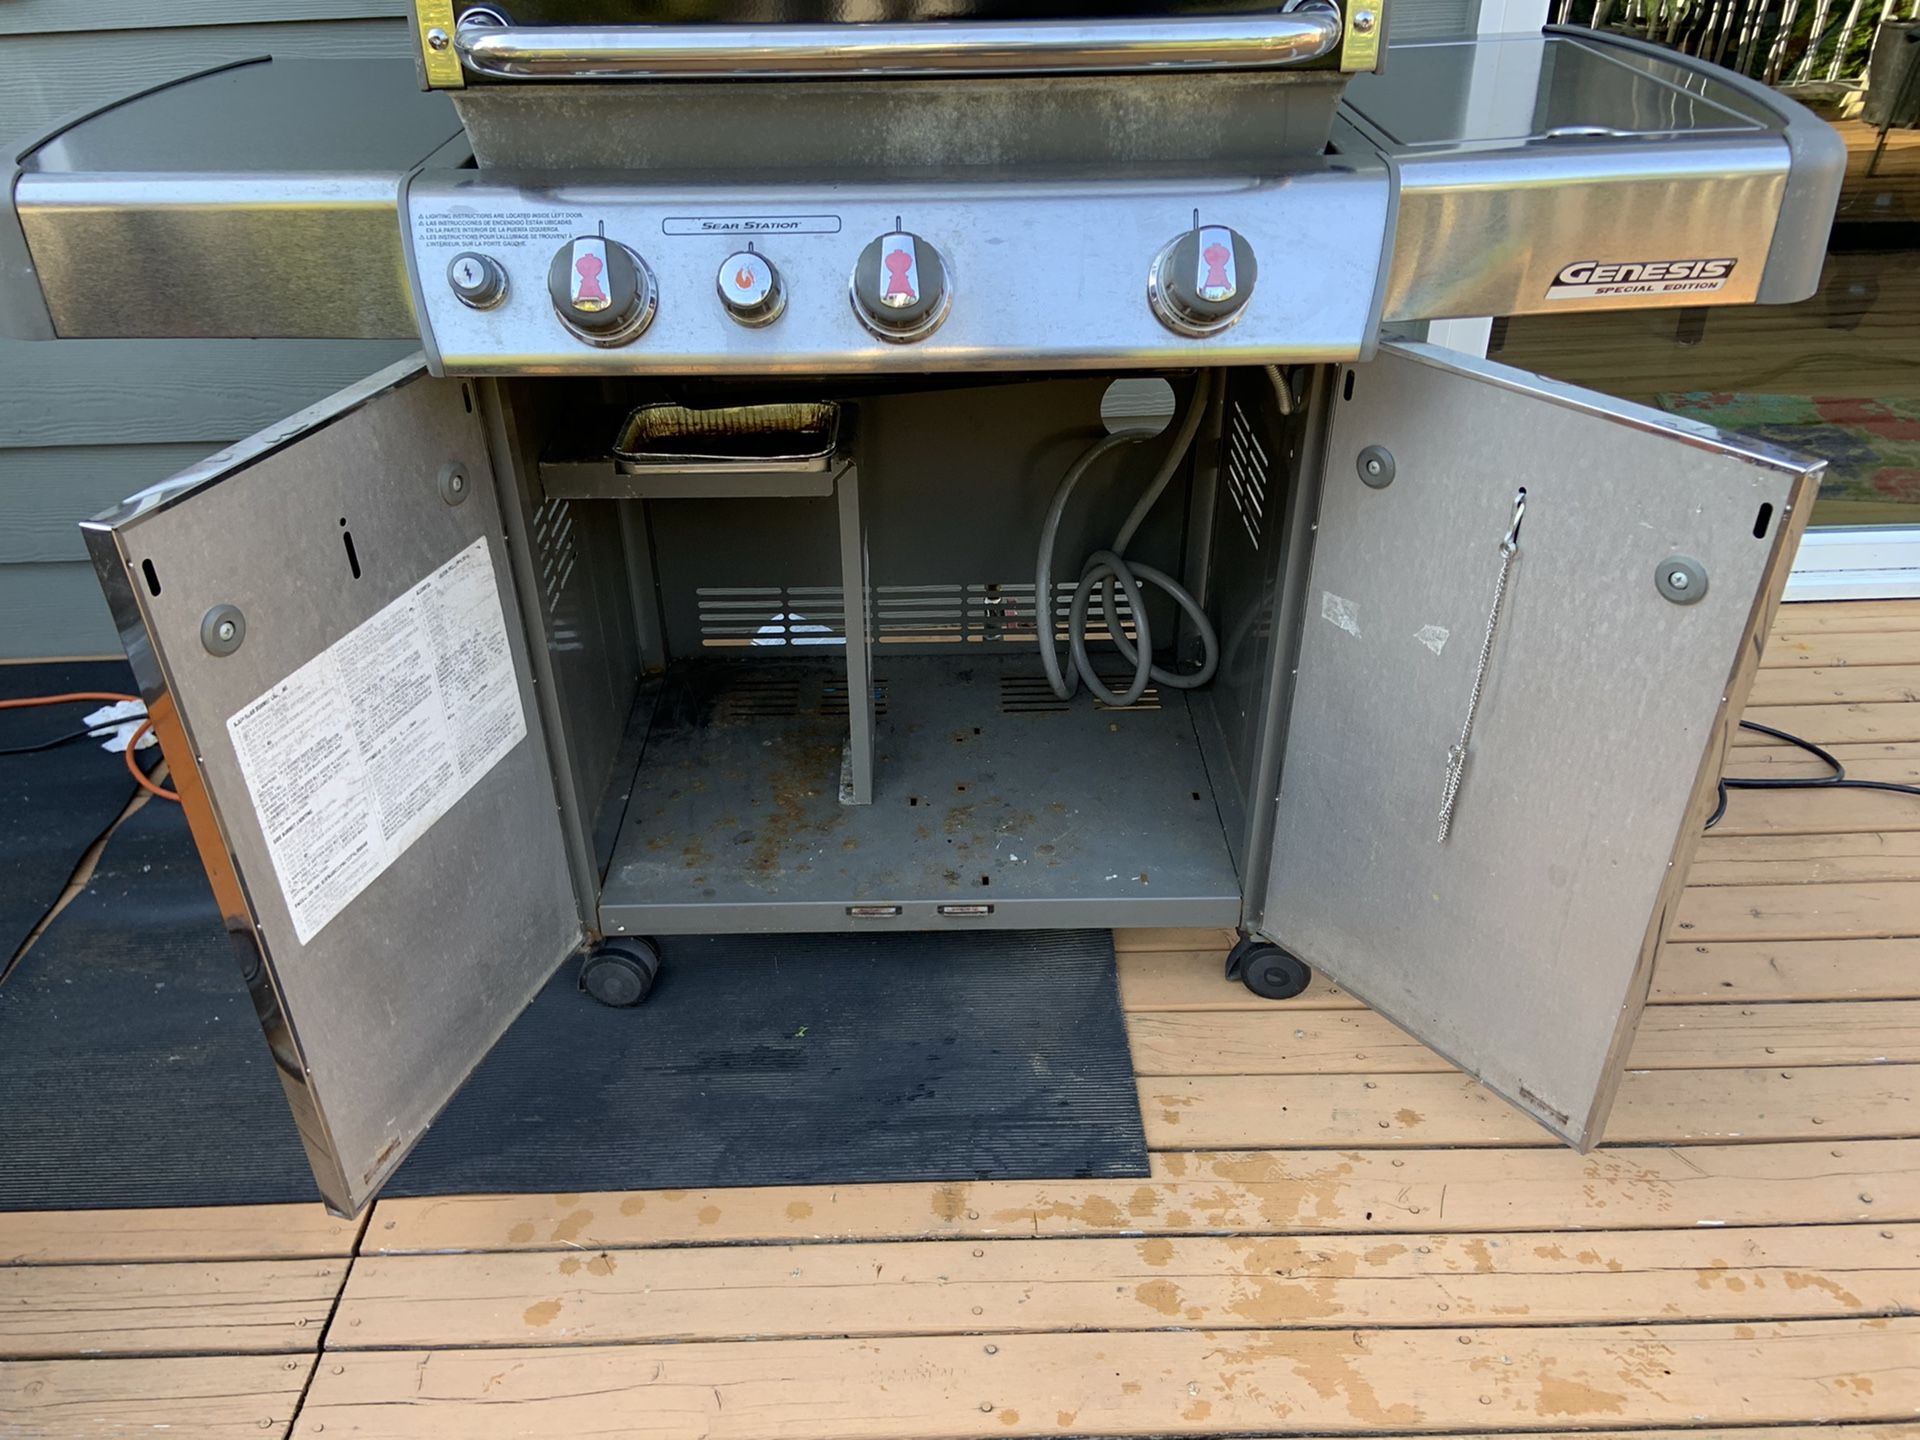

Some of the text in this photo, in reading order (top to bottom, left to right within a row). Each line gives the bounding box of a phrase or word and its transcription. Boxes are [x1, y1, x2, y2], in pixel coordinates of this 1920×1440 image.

[701, 222, 740, 230] SEAR
[1559, 260, 1731, 284] GENESIS
[1595, 282, 1719, 294] SPECIAL EDITION
